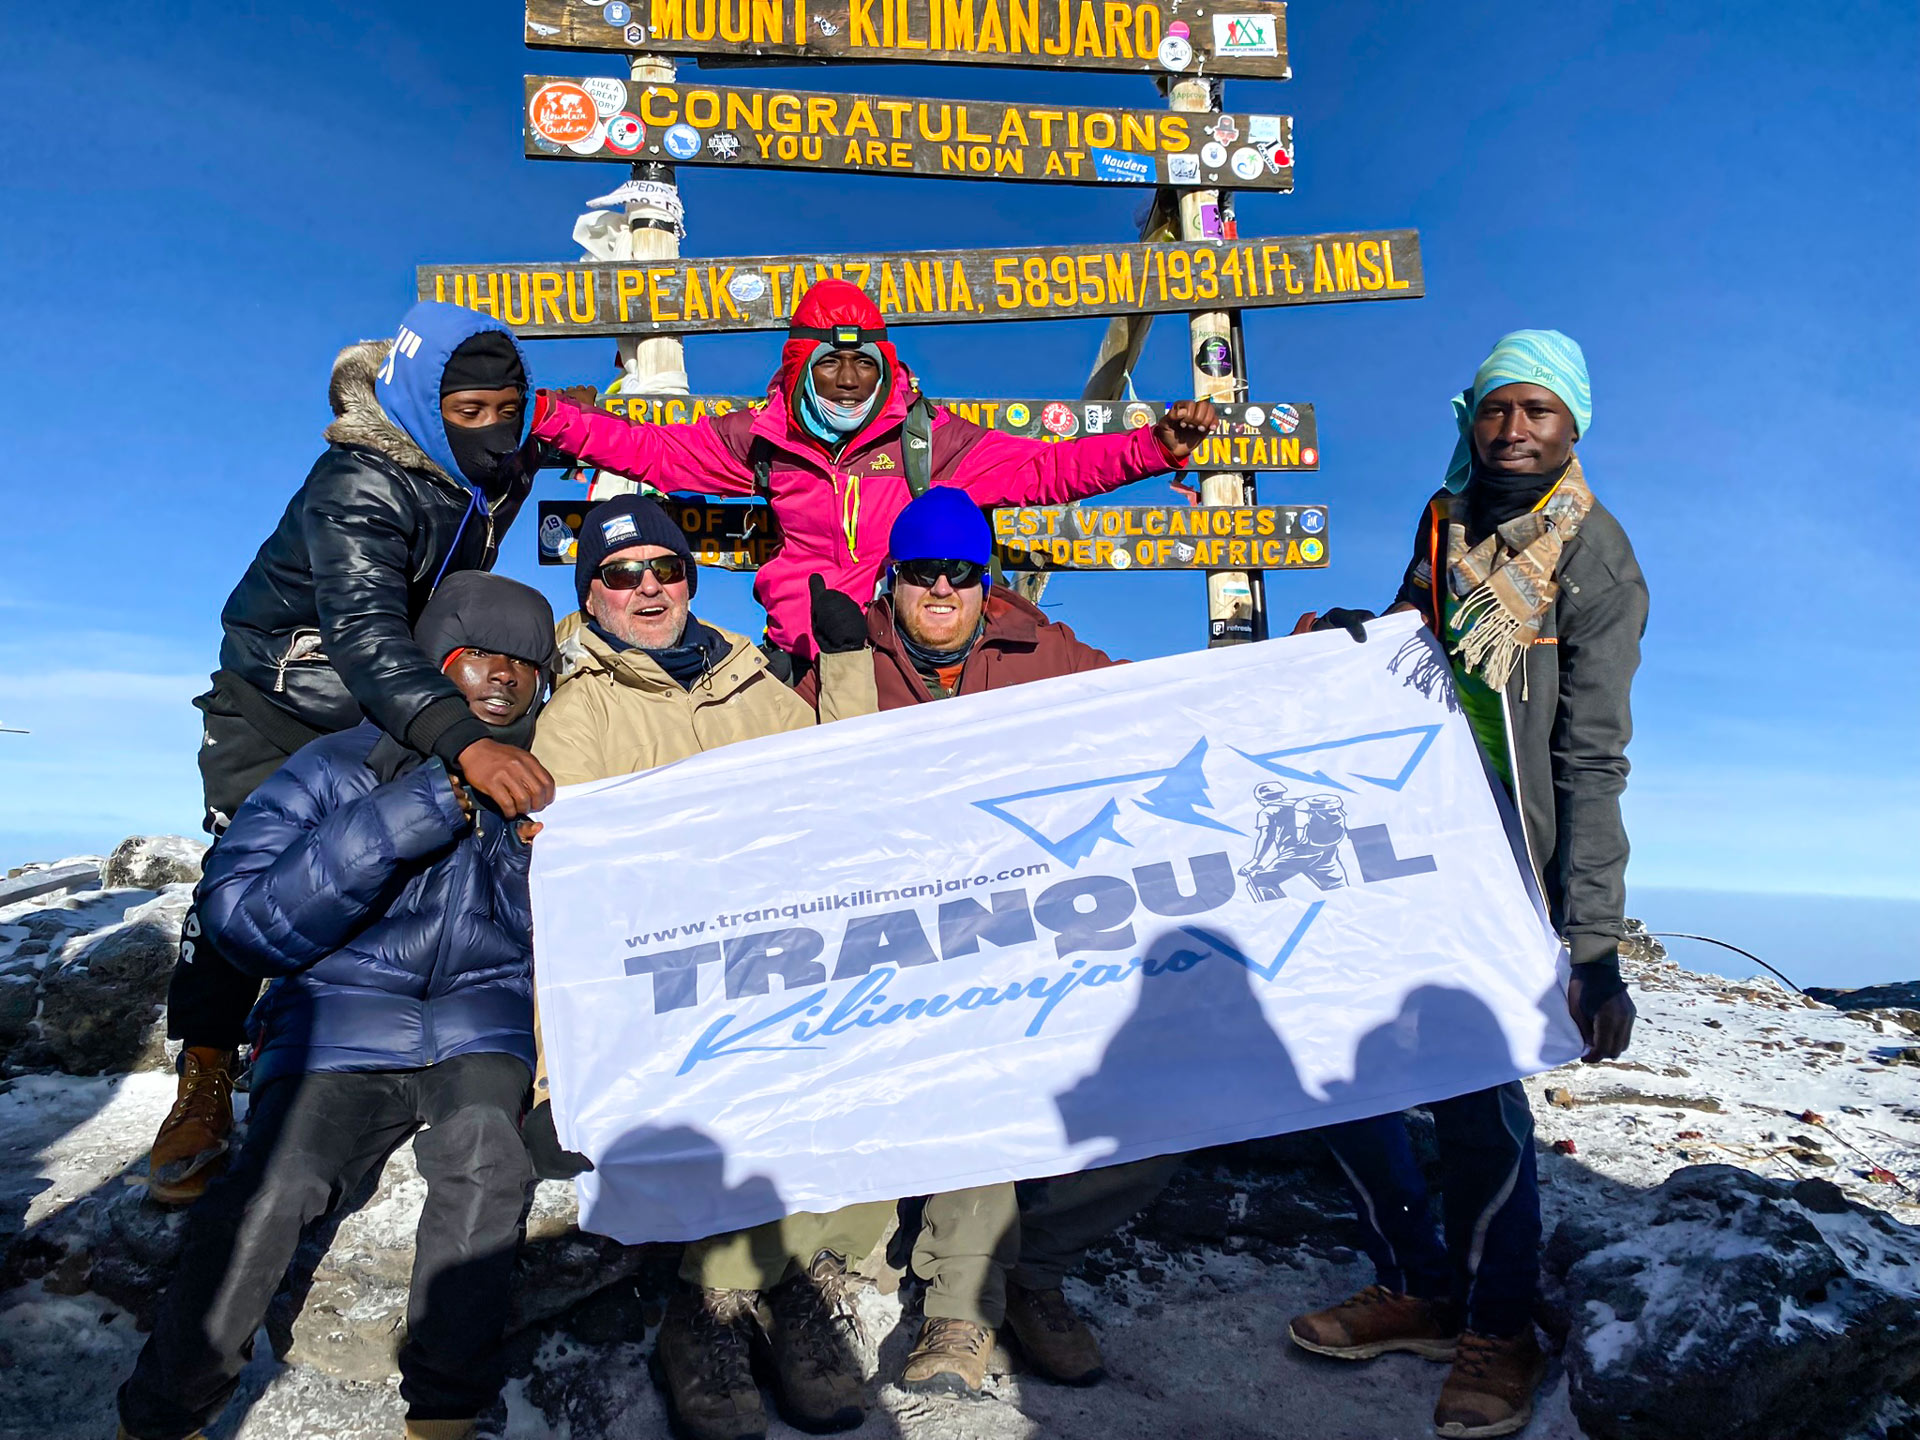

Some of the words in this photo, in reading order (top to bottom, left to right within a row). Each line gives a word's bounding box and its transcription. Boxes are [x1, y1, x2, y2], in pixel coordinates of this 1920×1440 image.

[849, 0, 1161, 59] KILIMANJARO
[589, 88, 618, 102] GREAT
[592, 80, 611, 90] LIVE
[541, 107, 587, 121] Mountain
[596, 99, 616, 110] ORY
[640, 86, 1191, 152] CONGRATULATIONS
[755, 134, 823, 160] YOU
[844, 138, 915, 169] ARE
[941, 144, 1024, 174] NOW
[1045, 150, 1085, 176] AT
[1101, 153, 1149, 174] Nauders
[436, 270, 595, 326] UHURU
[616, 266, 749, 323] PEAK,
[1313, 239, 1410, 293] AMSL
[1271, 408, 1300, 426] DURANGO
[1076, 509, 1276, 536] VOLCANOES
[607, 531, 638, 546] patagonia
[1135, 539, 1175, 565] OF
[1193, 539, 1304, 565] AFRICA
[625, 862, 1050, 949] www.tranquilkilimanjaro.com
[676, 949, 1212, 1076] Kilimanjaro
